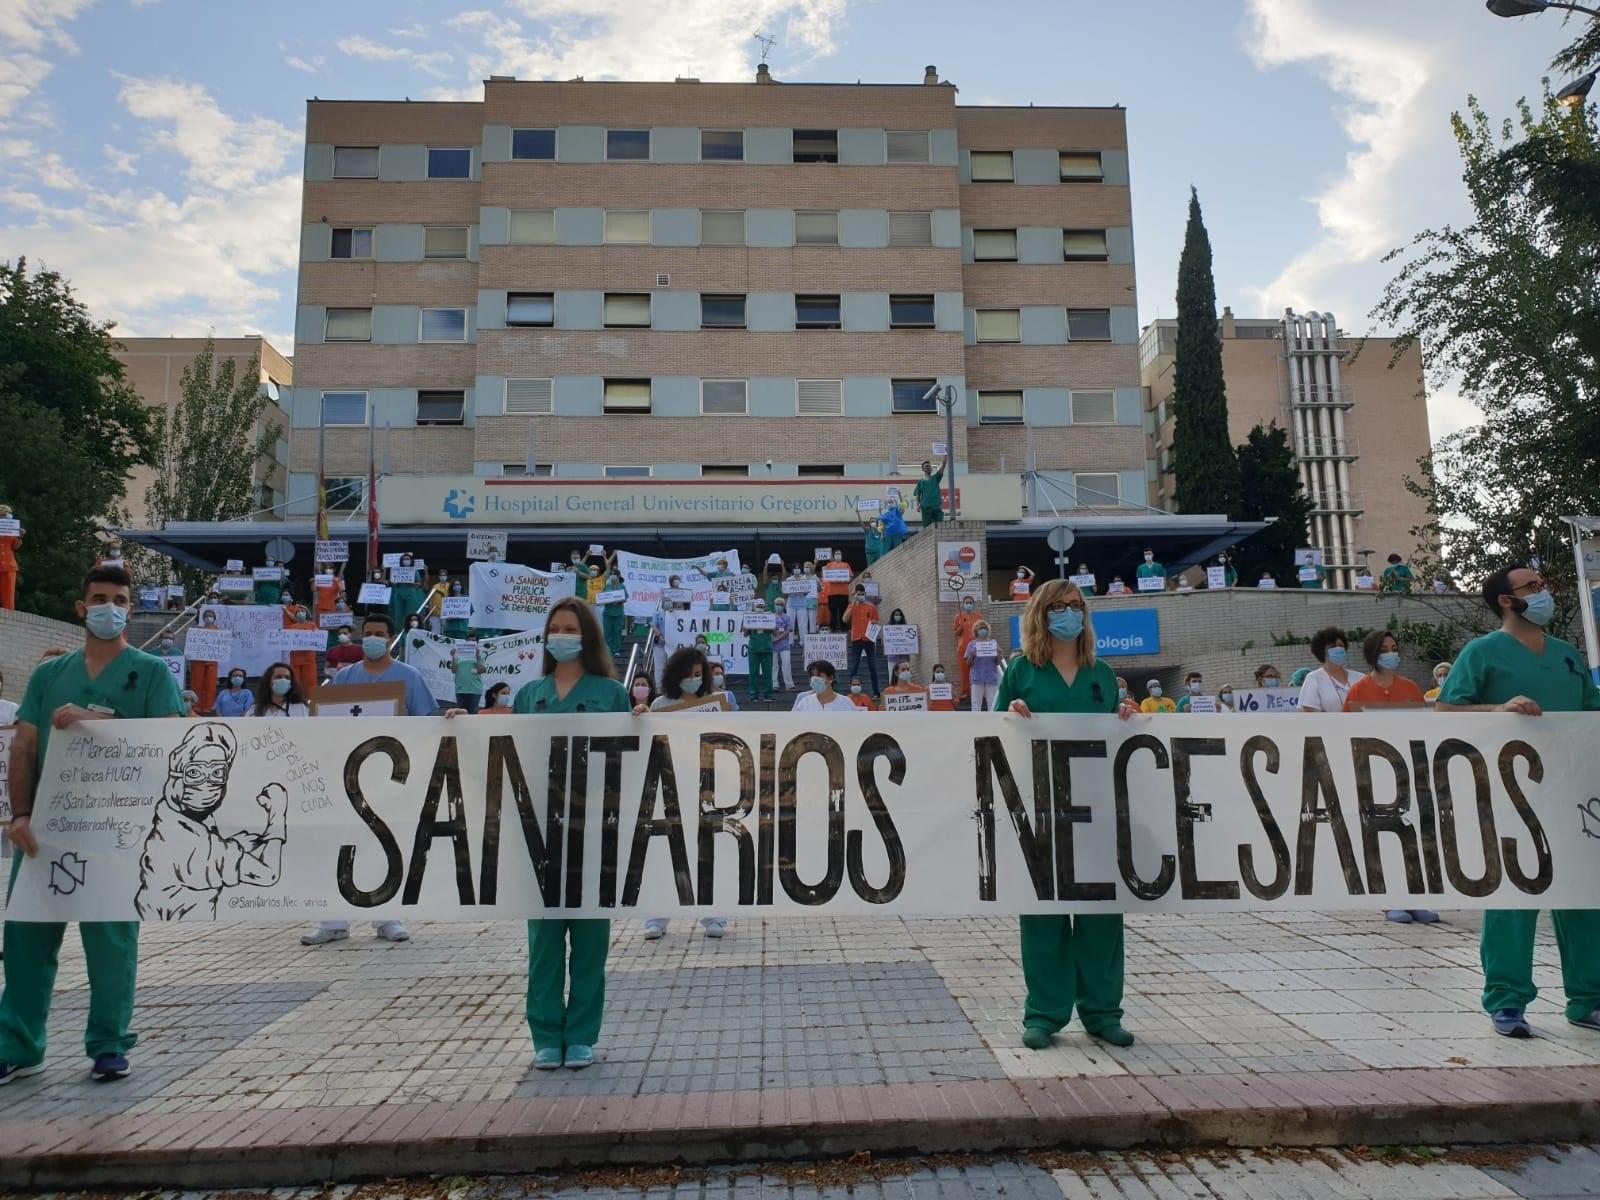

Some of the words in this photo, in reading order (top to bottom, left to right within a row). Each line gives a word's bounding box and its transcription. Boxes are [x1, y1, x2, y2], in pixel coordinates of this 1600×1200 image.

[485, 495, 559, 514] Hospital
[566, 495, 635, 512] General
[642, 495, 754, 512] Universitario
[760, 494, 838, 514] Gregorio
[504, 575, 515, 584] LA
[516, 575, 549, 587] SANIDAD
[500, 602, 510, 611] SE
[1097, 636, 1143, 649] ología
[1239, 692, 1259, 712] NO
[65, 737, 164, 759] #MareaMarañón
[266, 741, 297, 760] CUIDA
[286, 751, 304, 765] DE
[60, 766, 142, 782] @MareaHUGM
[301, 777, 326, 794] NOS
[49, 791, 154, 810] #SanitariosNecesarios
[301, 796, 333, 813] CUIDA
[337, 732, 906, 907] SANITARIOS
[974, 734, 1554, 901] NECESARIOS
